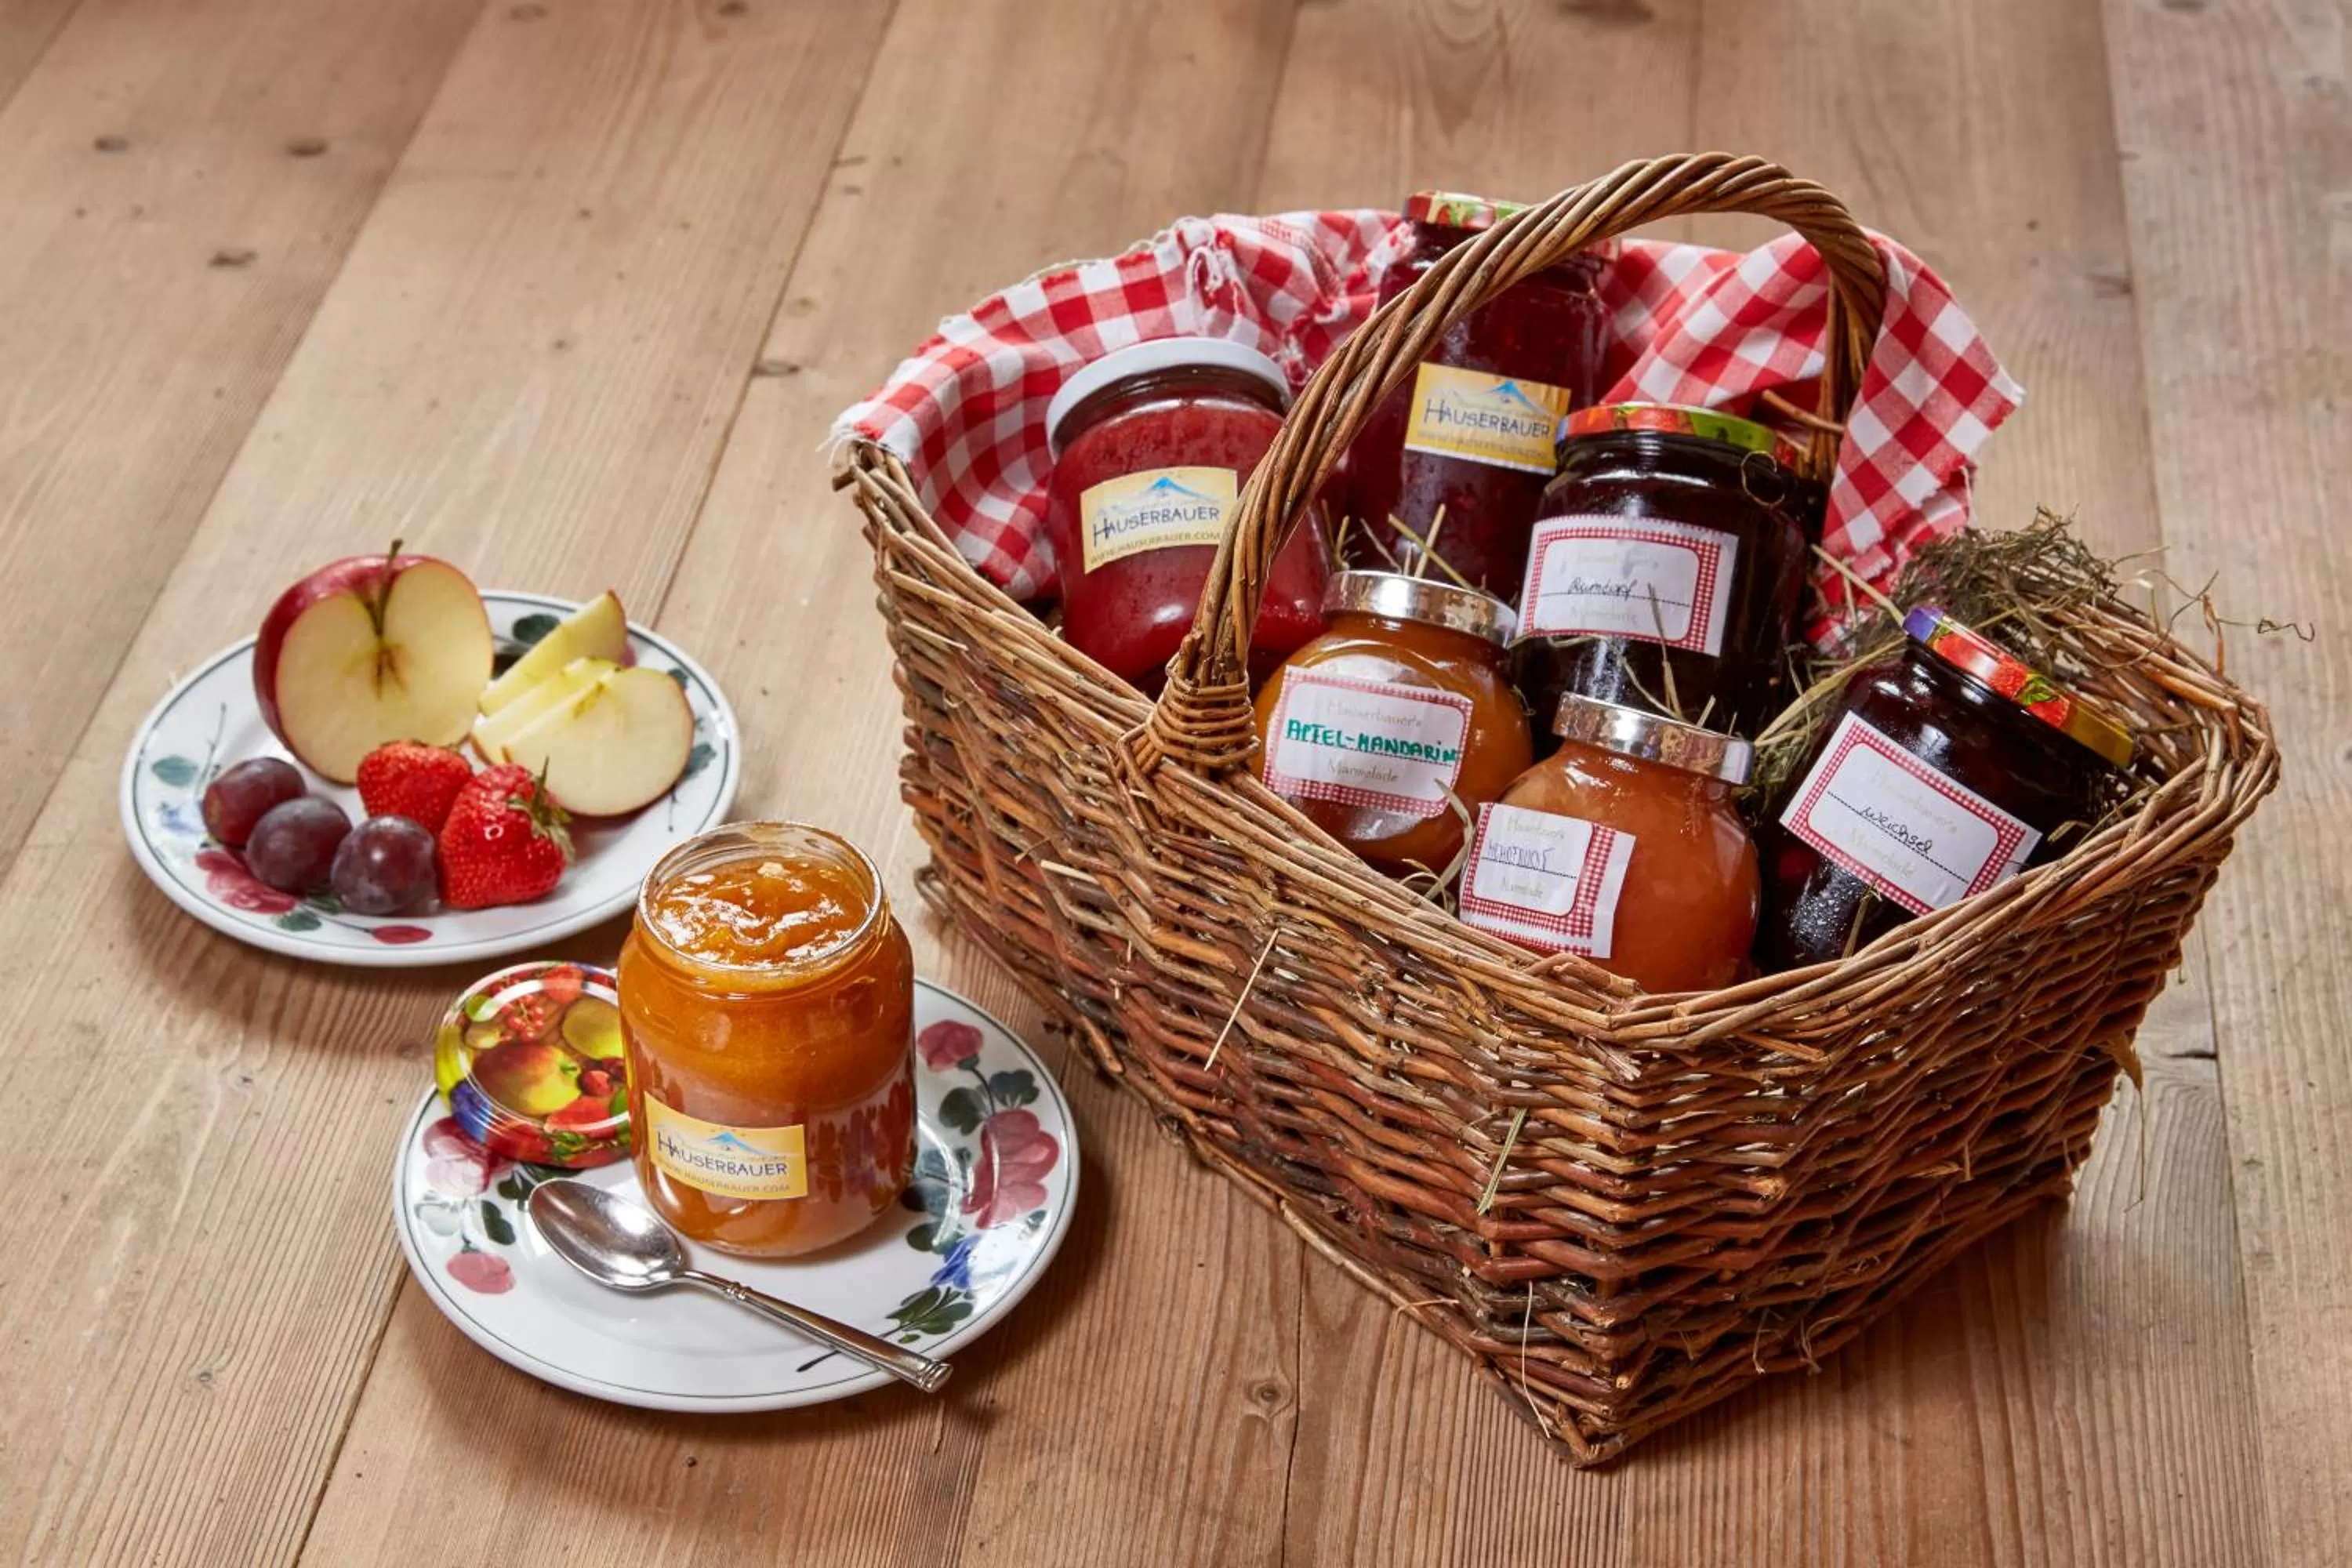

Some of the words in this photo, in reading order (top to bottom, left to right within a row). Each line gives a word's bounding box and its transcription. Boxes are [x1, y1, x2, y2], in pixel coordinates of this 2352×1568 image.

[1423, 397, 1550, 437] HAUSERBAUER
[1092, 506, 1220, 548] HAUSERBAUER
[657, 1131, 788, 1177] HAUSERBAUER
